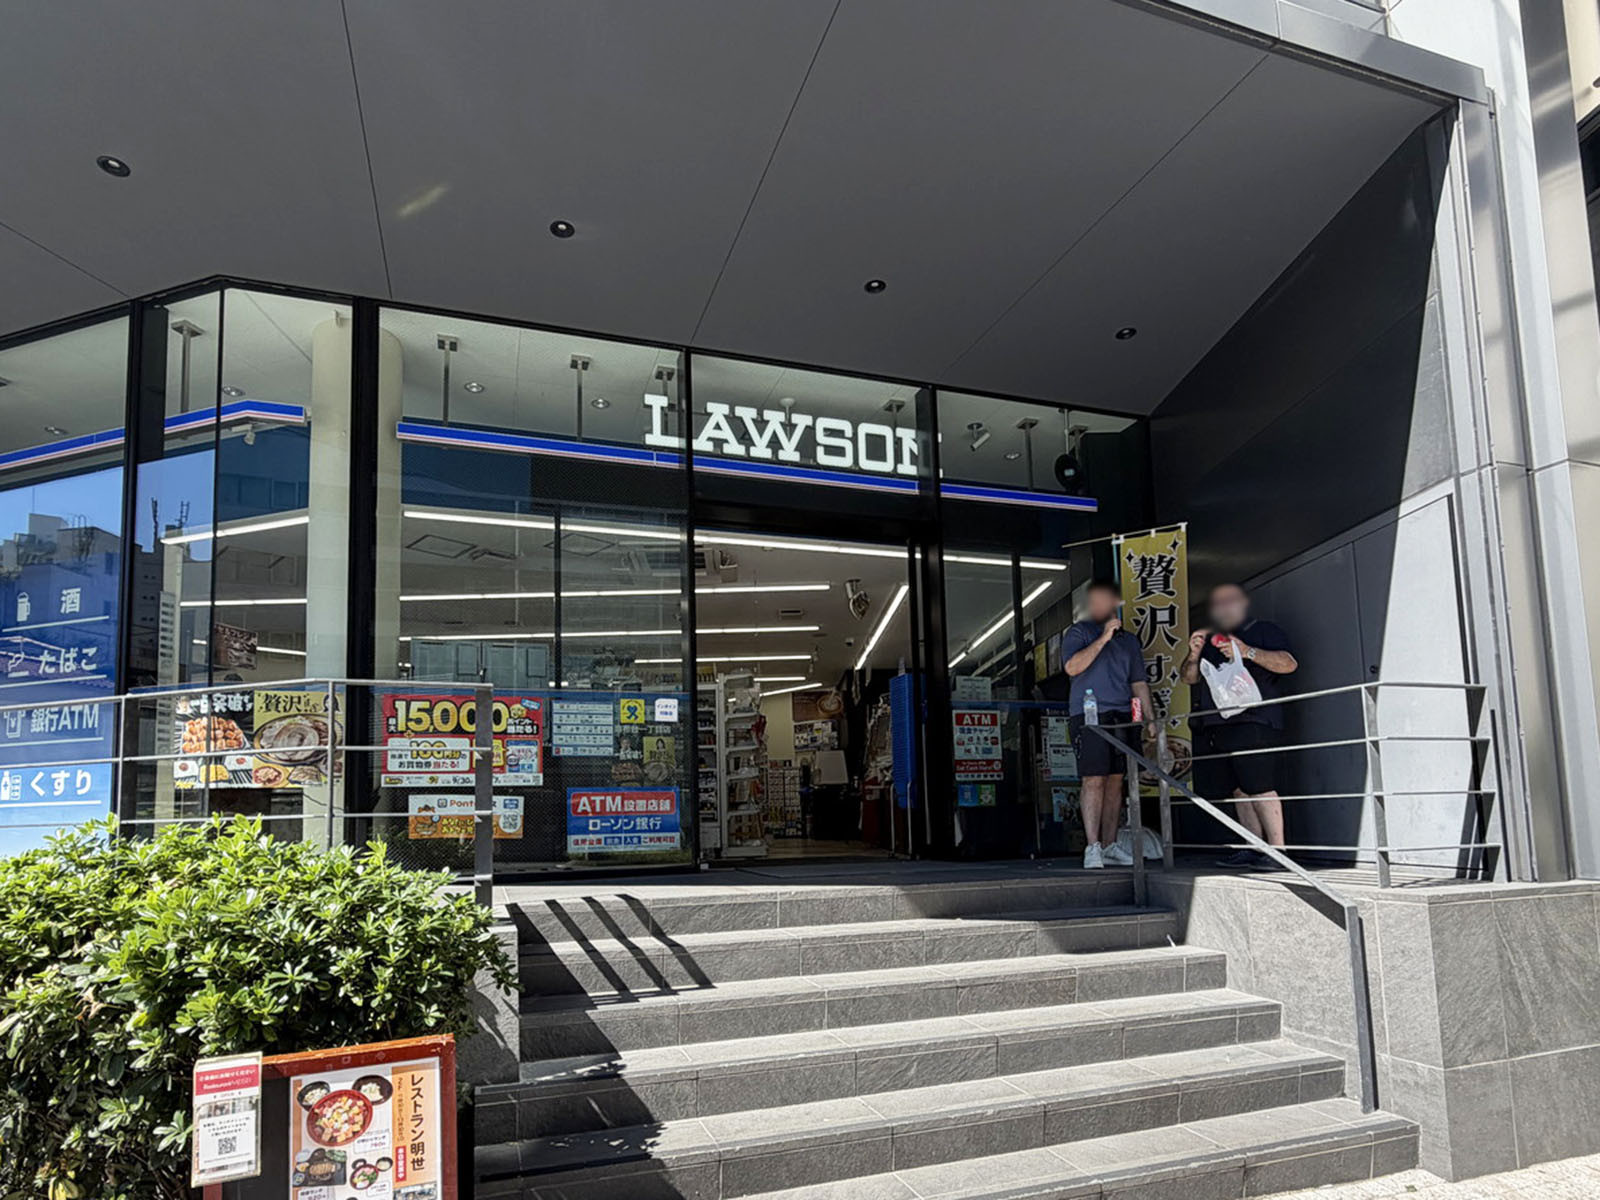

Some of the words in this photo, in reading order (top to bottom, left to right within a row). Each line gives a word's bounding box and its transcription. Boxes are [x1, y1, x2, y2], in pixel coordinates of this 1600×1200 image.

[60, 588, 81, 614] 酒
[38, 646, 98, 674] たばこ
[30, 703, 99, 732] 銀行ATM
[962, 714, 992, 726] ATM
[30, 769, 92, 796] くすり
[577, 795, 671, 813] ATM設置店舗
[588, 817, 662, 831] ローソン銀行
[410, 1074, 425, 1171] レストラン明世
